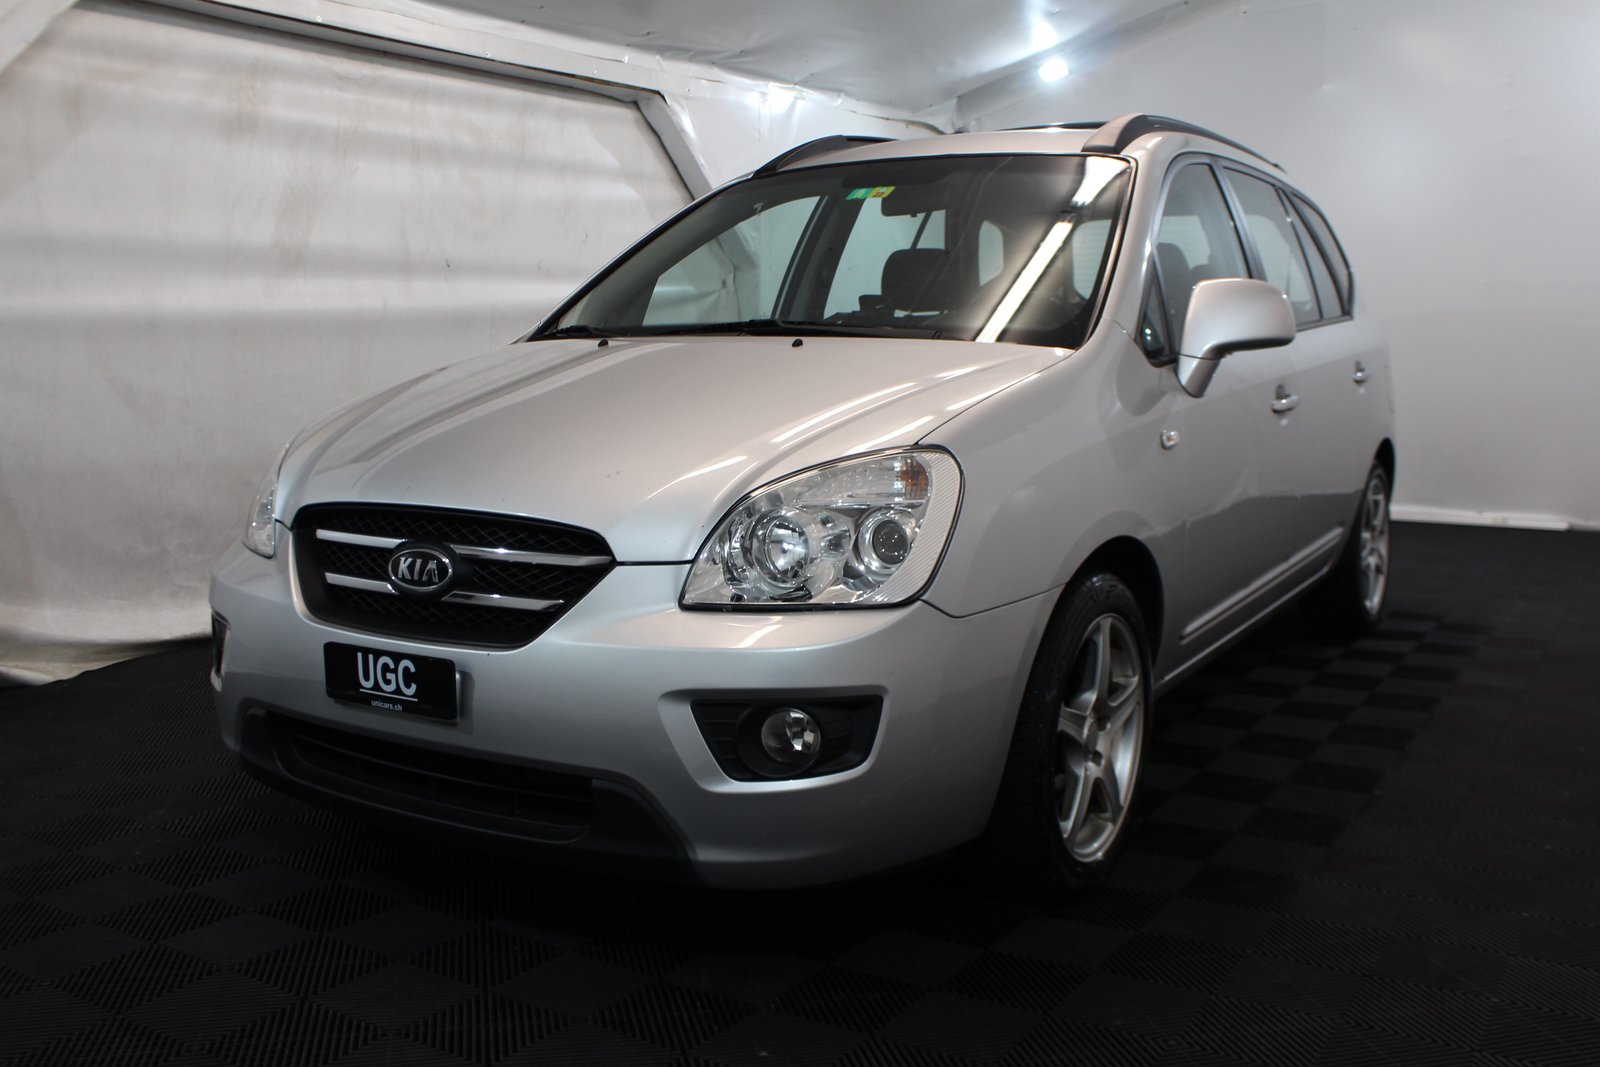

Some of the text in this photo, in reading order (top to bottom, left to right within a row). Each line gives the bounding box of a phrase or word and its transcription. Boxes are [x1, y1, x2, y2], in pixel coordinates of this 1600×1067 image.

[399, 557, 439, 583] KIA
[357, 652, 417, 696] UGC
[371, 700, 403, 711] unicars.ch
